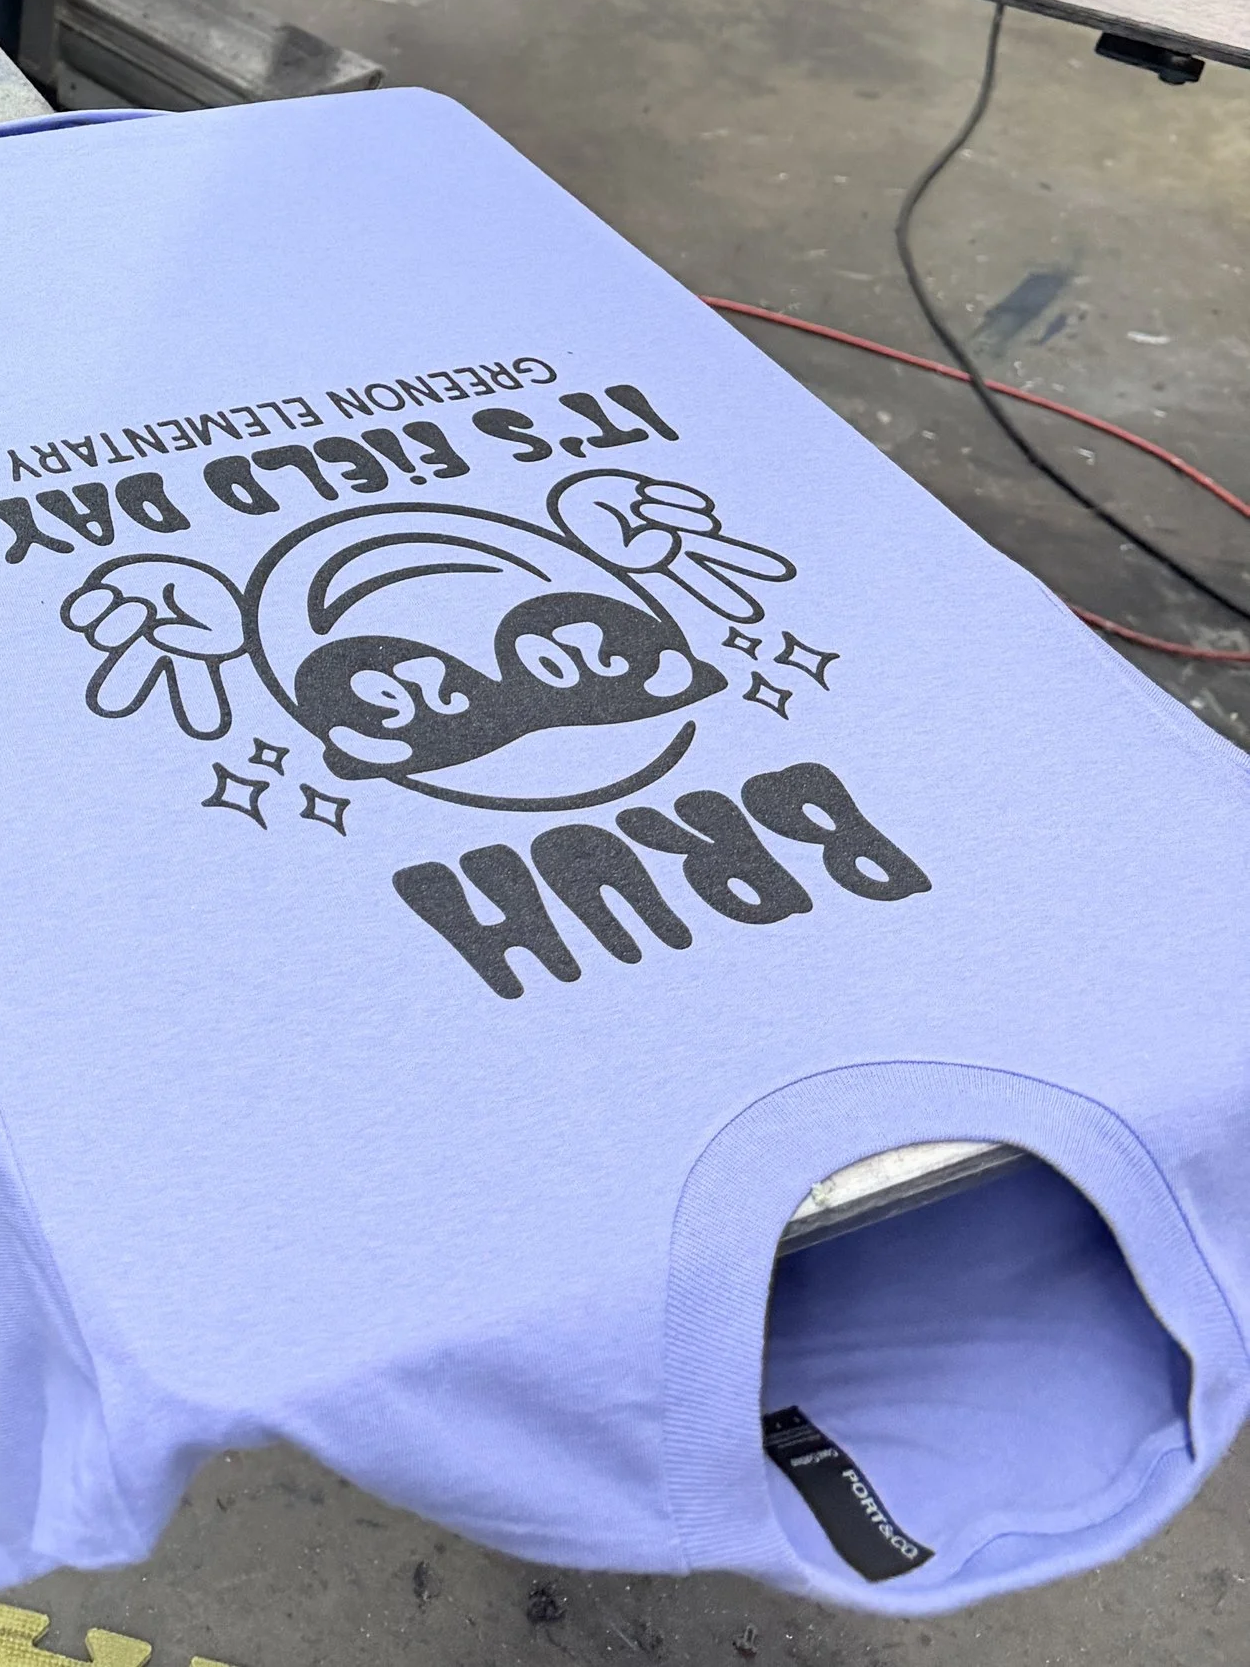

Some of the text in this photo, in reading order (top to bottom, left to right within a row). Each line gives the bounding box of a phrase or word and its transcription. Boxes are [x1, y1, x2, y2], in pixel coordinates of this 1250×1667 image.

[7, 357, 558, 482] GREENON ELEMENTARY
[471, 384, 680, 463] IT'S
[350, 621, 629, 729] 20 26
[391, 762, 933, 1000] BRUH
